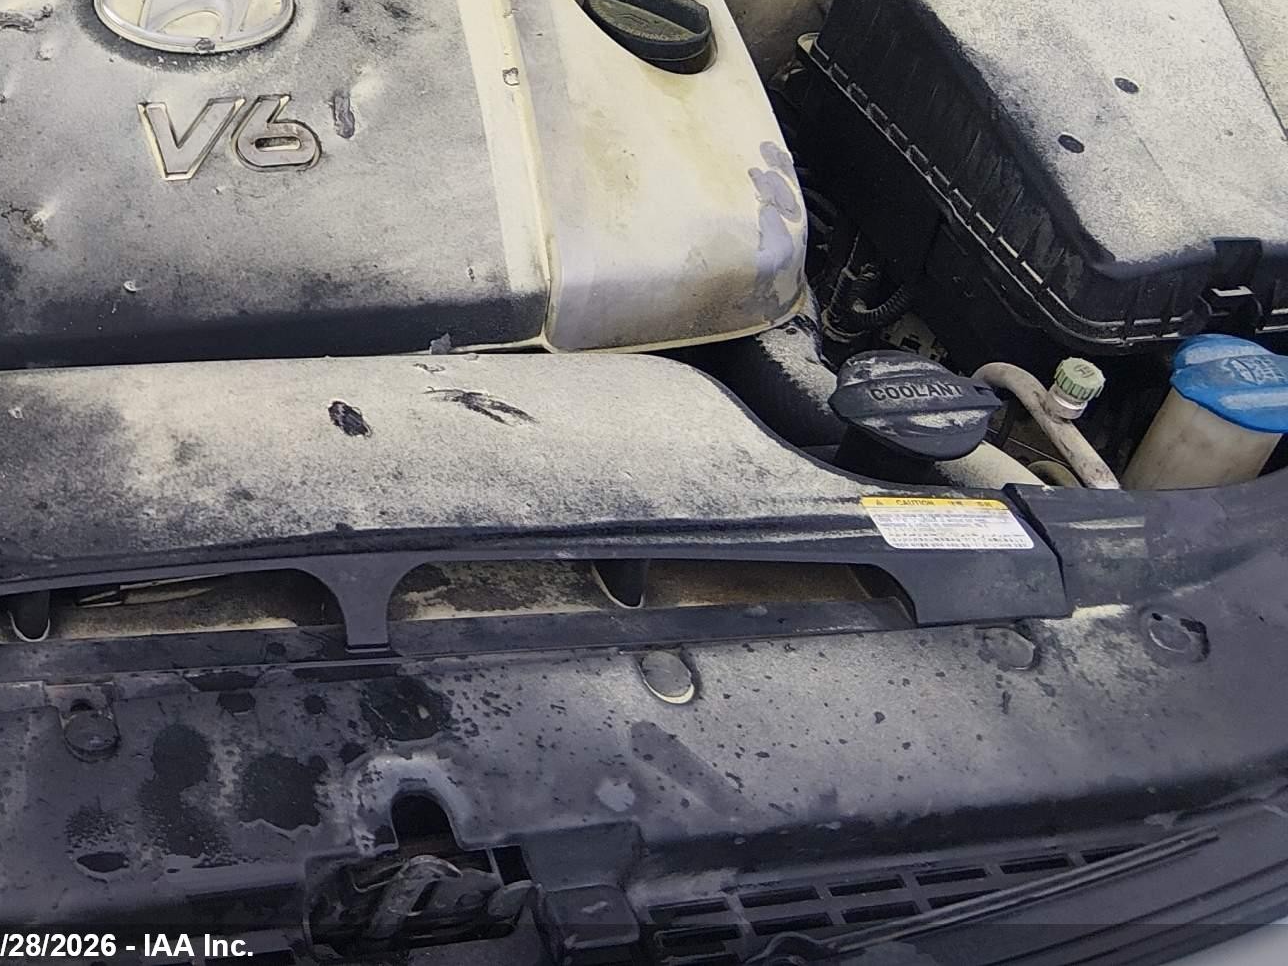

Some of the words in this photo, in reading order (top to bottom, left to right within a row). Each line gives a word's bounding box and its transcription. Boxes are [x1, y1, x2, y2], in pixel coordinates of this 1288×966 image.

[137, 94, 323, 181] V6
[869, 382, 964, 402] COOLANT
[895, 499, 935, 507] CAUTION
